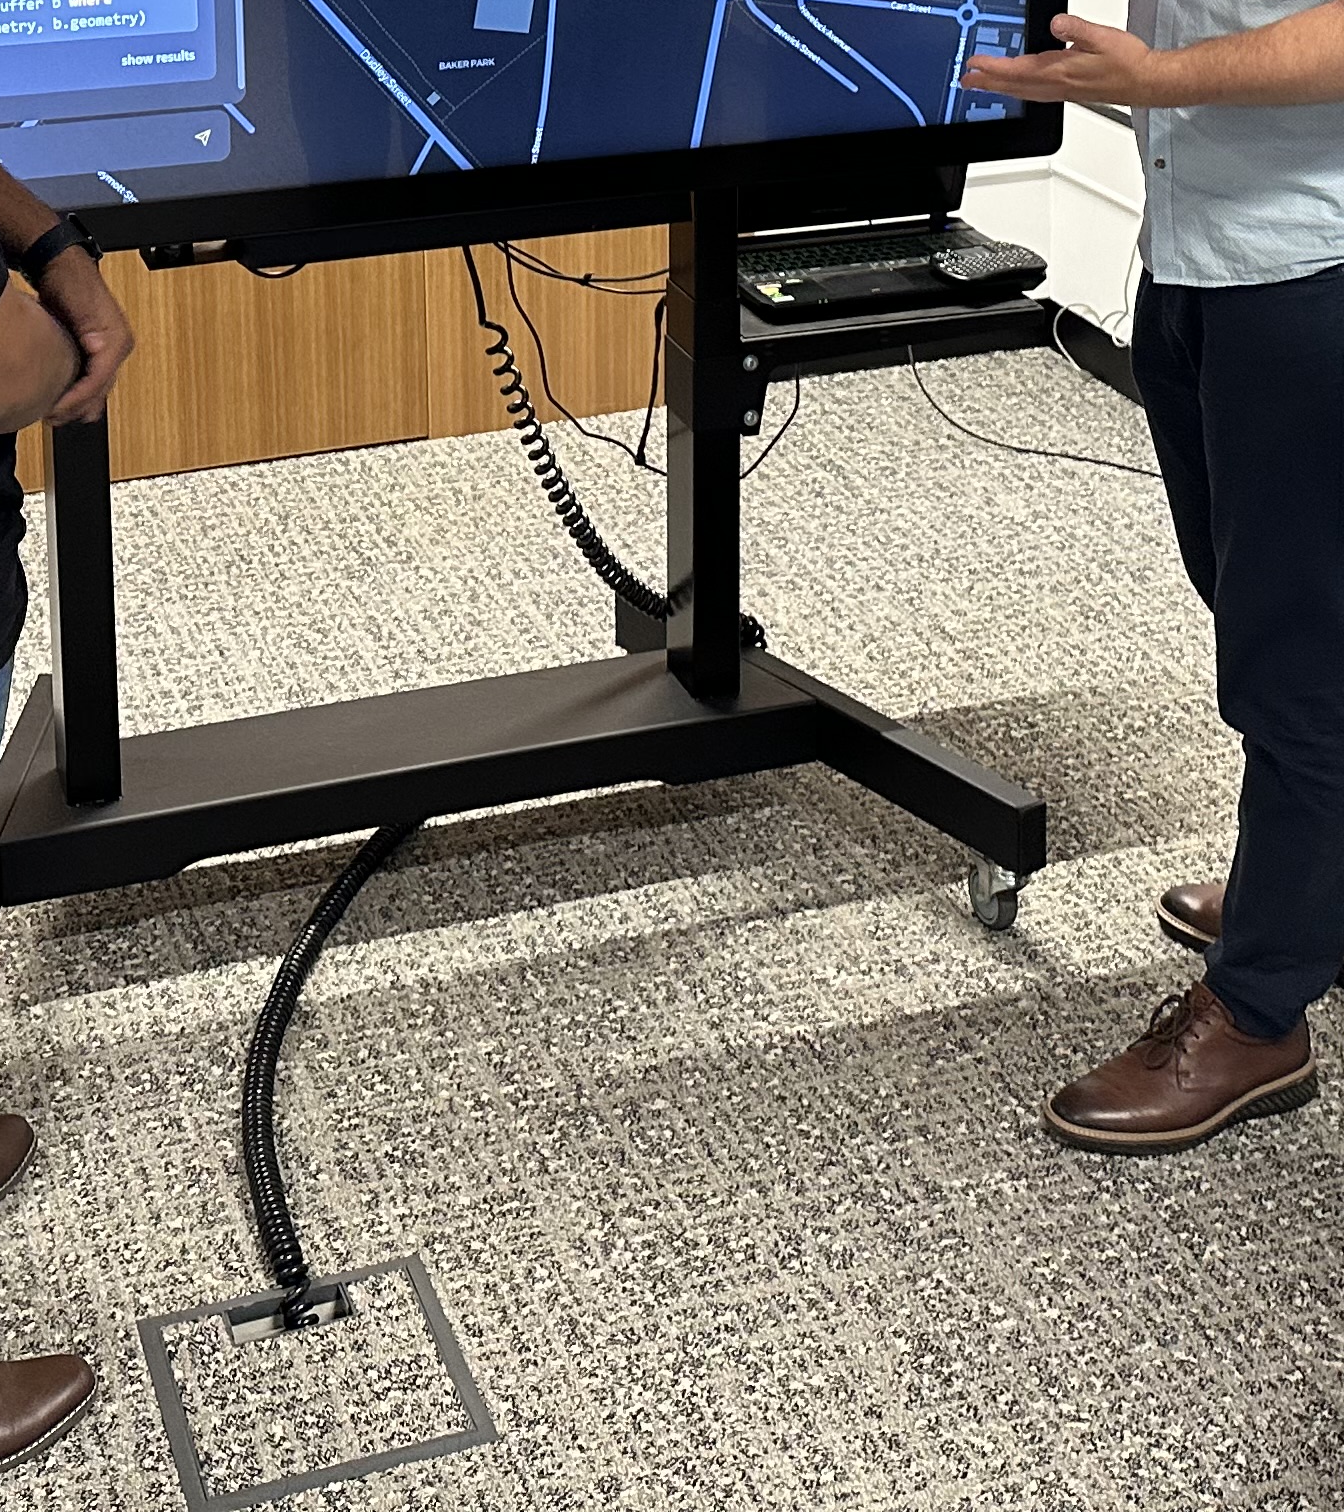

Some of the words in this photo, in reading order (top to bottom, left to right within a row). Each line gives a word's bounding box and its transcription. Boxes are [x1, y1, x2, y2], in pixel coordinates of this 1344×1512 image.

[890, 0, 908, 11] Carr
[908, 3, 932, 14] Street
[53, 9, 147, 32] b.geometry)
[121, 53, 154, 67] show
[156, 49, 196, 64] results
[799, 42, 822, 65] Street
[955, 36, 967, 65] Street
[438, 59, 470, 71] BAKER
[470, 57, 496, 69] PARK
[359, 48, 389, 82] Dudley
[386, 78, 413, 108] Street
[532, 126, 544, 154] Street
